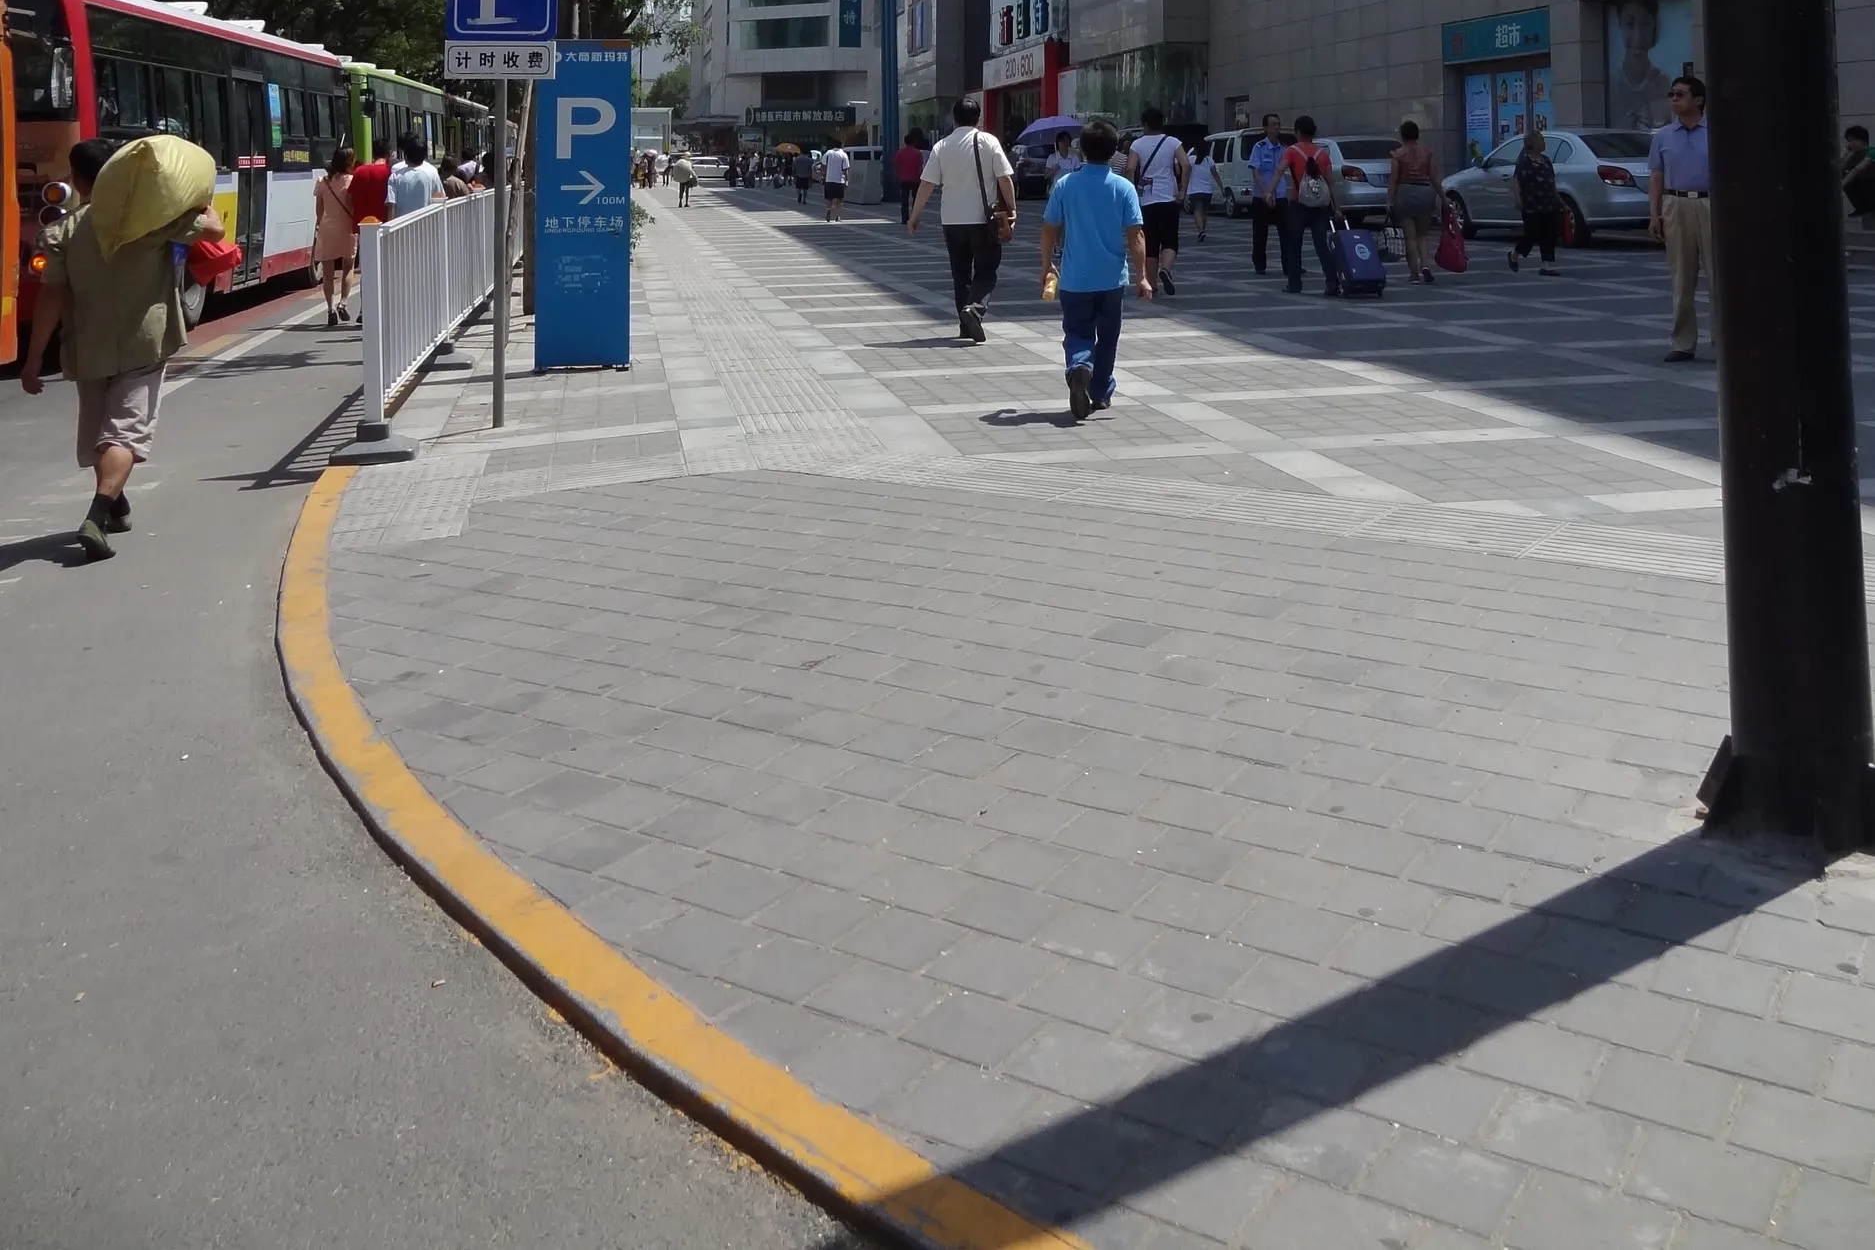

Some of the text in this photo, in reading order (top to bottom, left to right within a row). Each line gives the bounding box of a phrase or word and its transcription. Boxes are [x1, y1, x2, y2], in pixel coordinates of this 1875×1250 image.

[1495, 22, 1522, 48] 超市
[455, 51, 544, 69] 计时收费
[565, 51, 629, 62] 大商新玛特
[556, 97, 617, 160] P
[596, 196, 625, 205] 100M
[544, 216, 624, 229] 地下停车场
